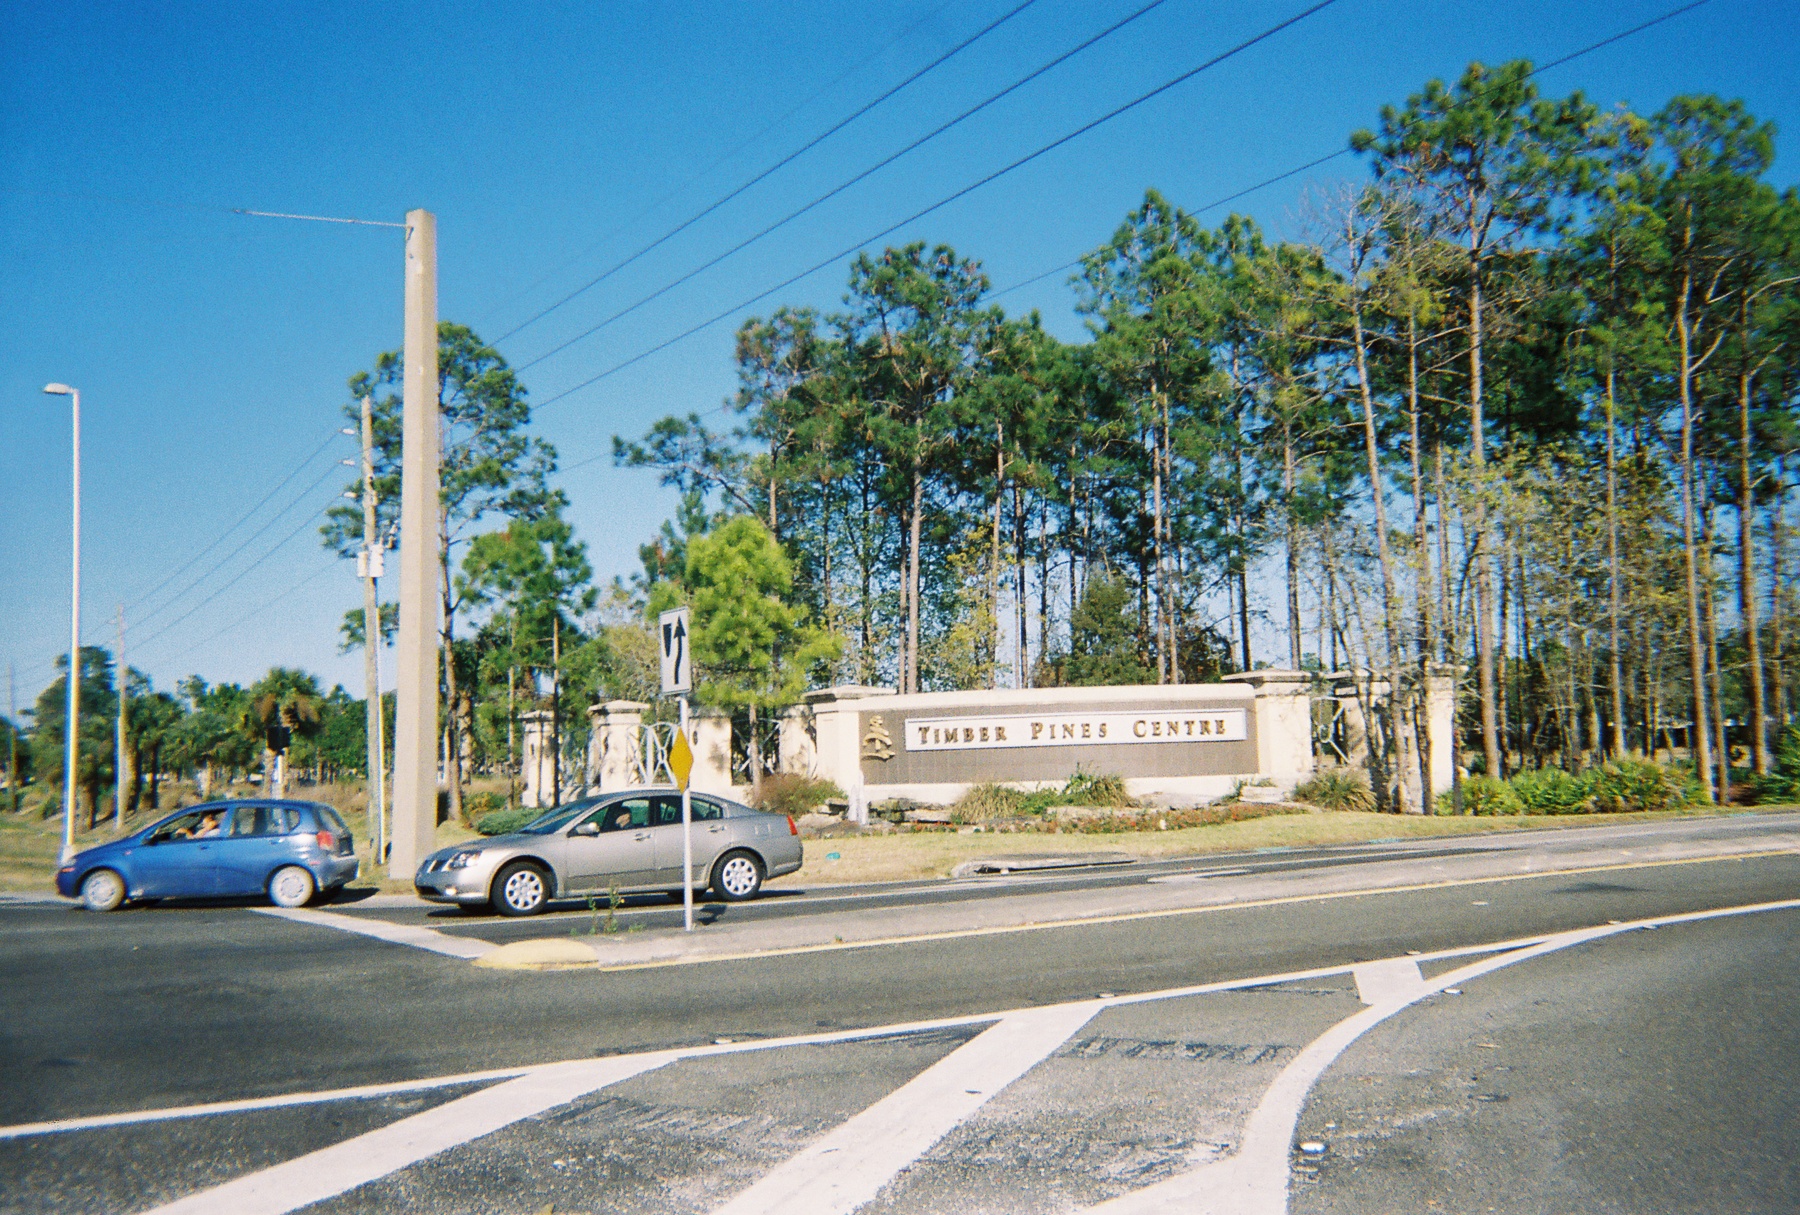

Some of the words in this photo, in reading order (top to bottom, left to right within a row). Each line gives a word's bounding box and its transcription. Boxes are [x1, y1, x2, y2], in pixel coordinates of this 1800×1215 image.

[918, 725, 1007, 745] TIMBER
[1030, 721, 1108, 740] PINES
[1132, 718, 1227, 738] CENTRE
